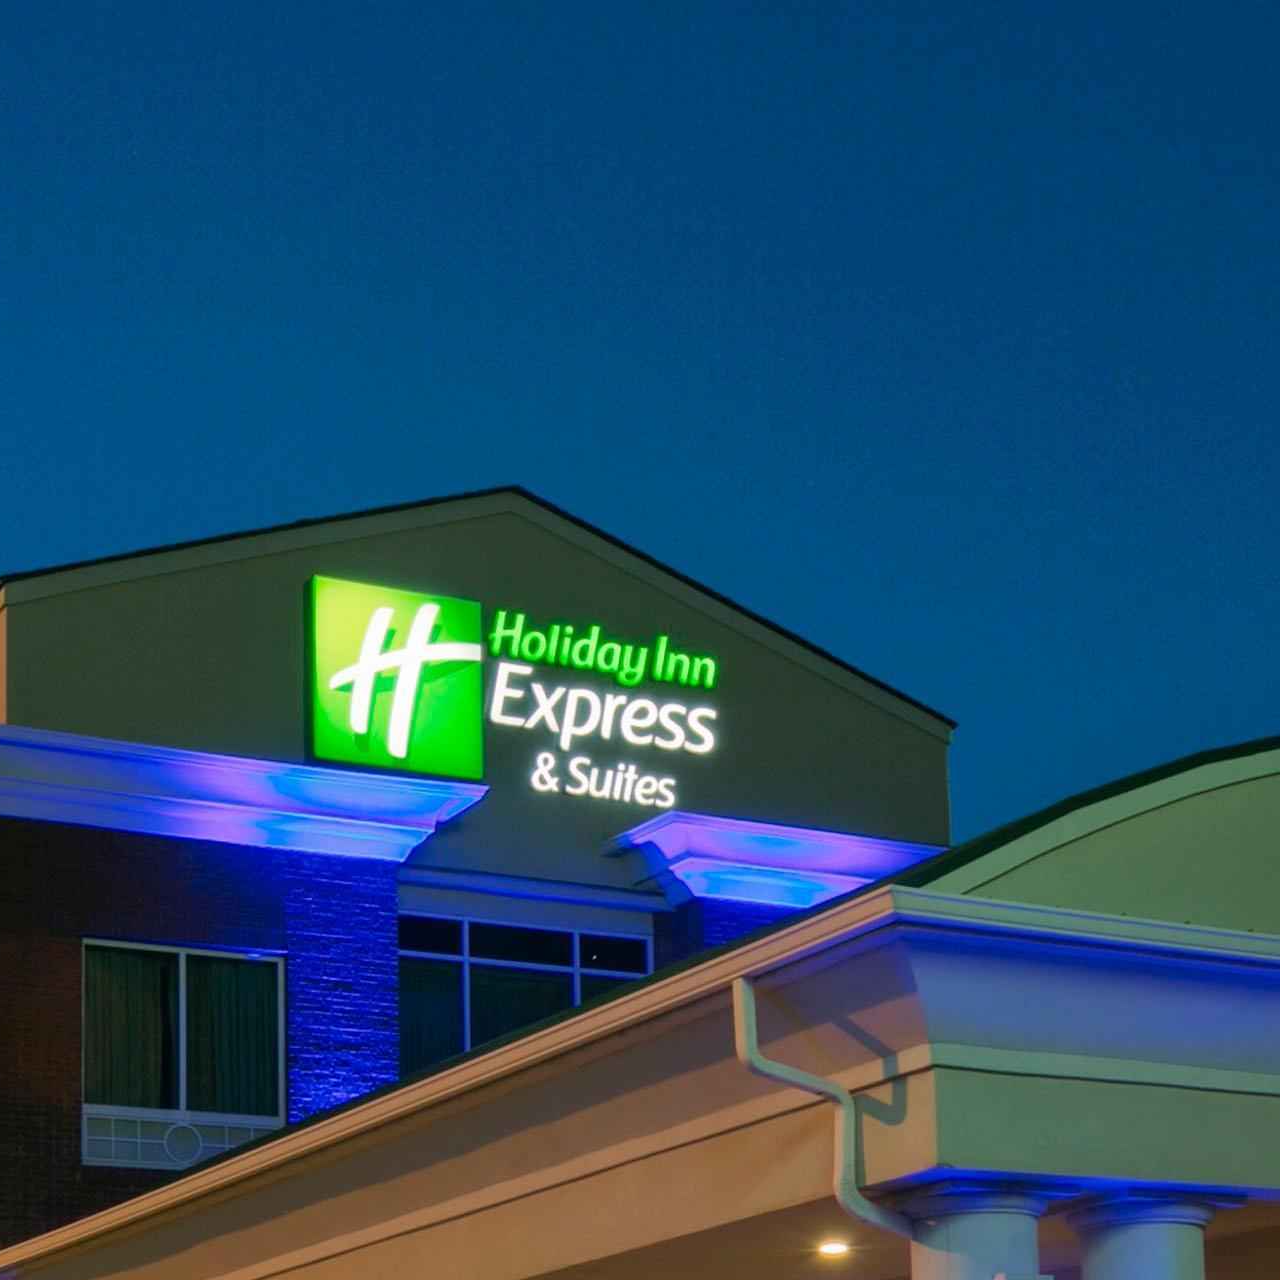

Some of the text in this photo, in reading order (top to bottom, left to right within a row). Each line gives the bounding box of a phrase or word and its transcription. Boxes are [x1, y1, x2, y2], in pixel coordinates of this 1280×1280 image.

[488, 610, 717, 689] Holiday Inn
[489, 661, 718, 755] Express
[530, 751, 677, 808] & Suites
